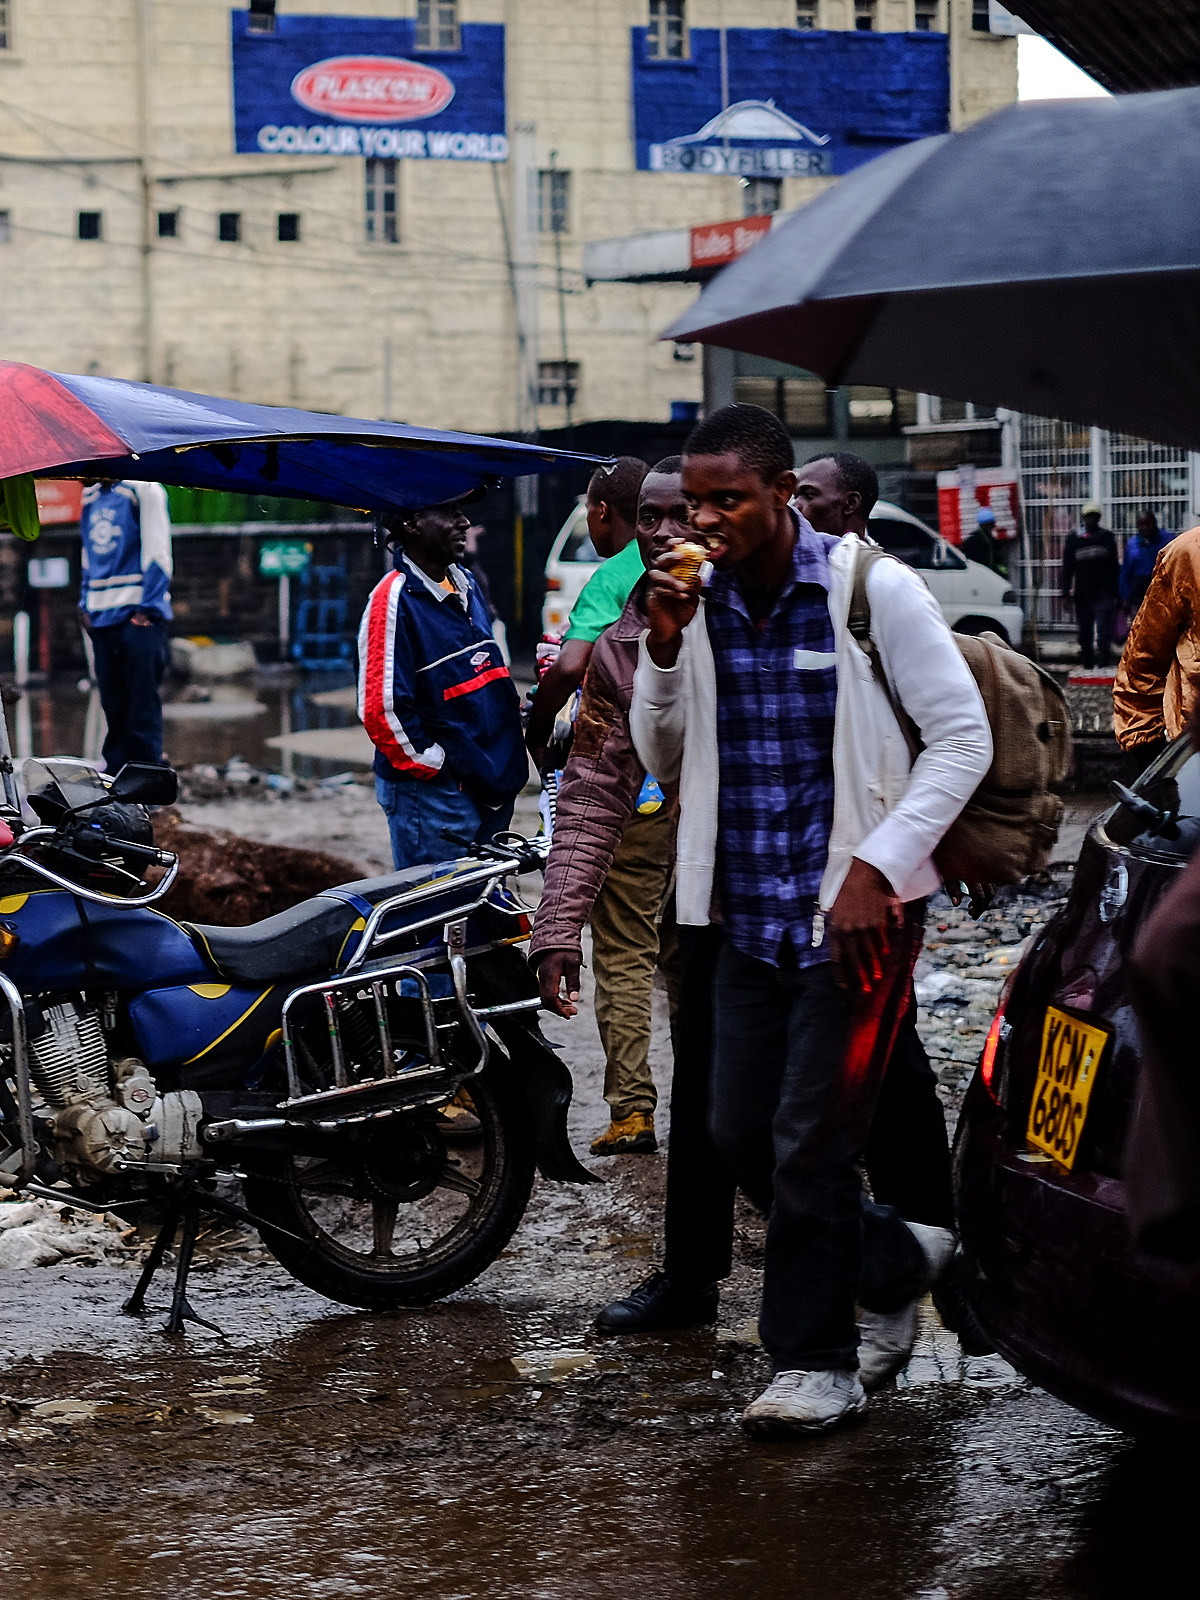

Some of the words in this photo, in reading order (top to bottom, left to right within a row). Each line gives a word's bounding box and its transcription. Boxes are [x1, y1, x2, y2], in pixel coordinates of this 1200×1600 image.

[313, 74, 431, 101] PLASCON
[257, 125, 360, 152] COLOUR
[359, 127, 426, 157] YOUR
[427, 131, 509, 161] WORLD
[1042, 1017, 1087, 1090] KCN
[1033, 1079, 1083, 1160] 680S
